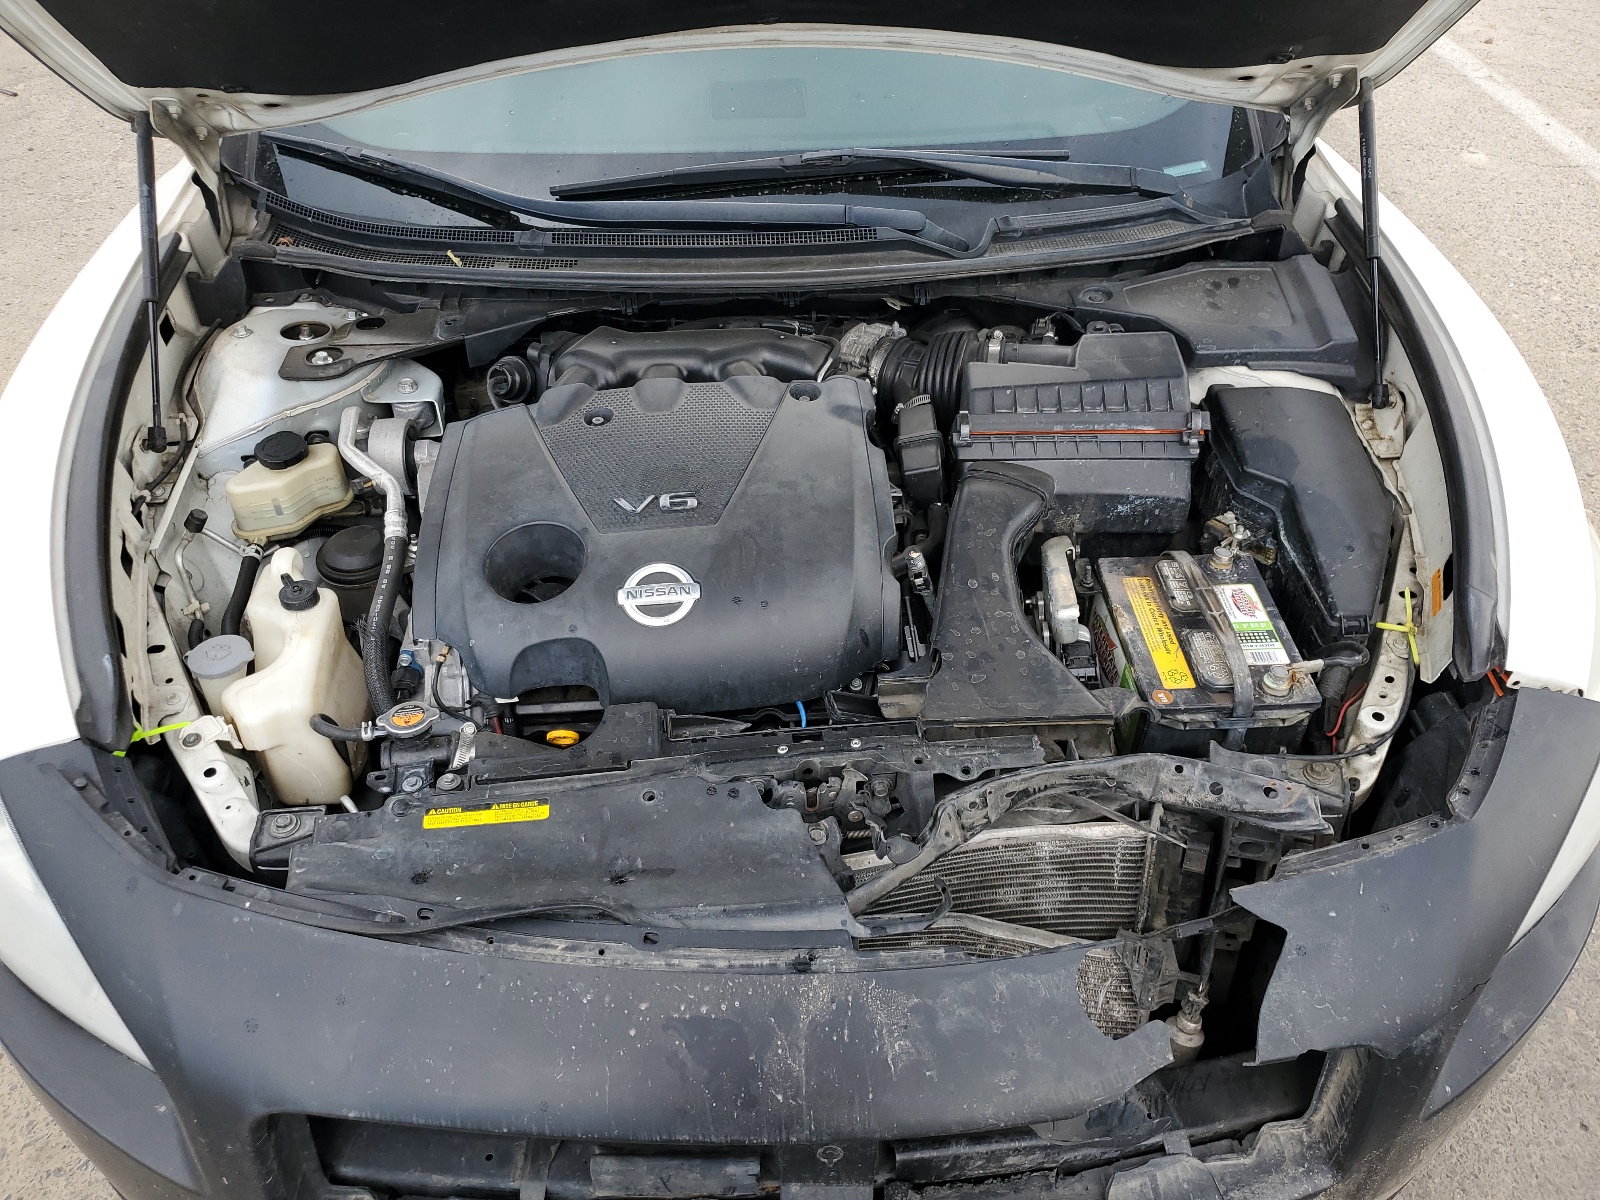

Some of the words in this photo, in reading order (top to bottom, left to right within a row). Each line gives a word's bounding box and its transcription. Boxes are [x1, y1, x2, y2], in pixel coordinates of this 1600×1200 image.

[613, 491, 698, 513] V6
[626, 586, 691, 600] NISSAN
[436, 807, 462, 815] CAUTION
